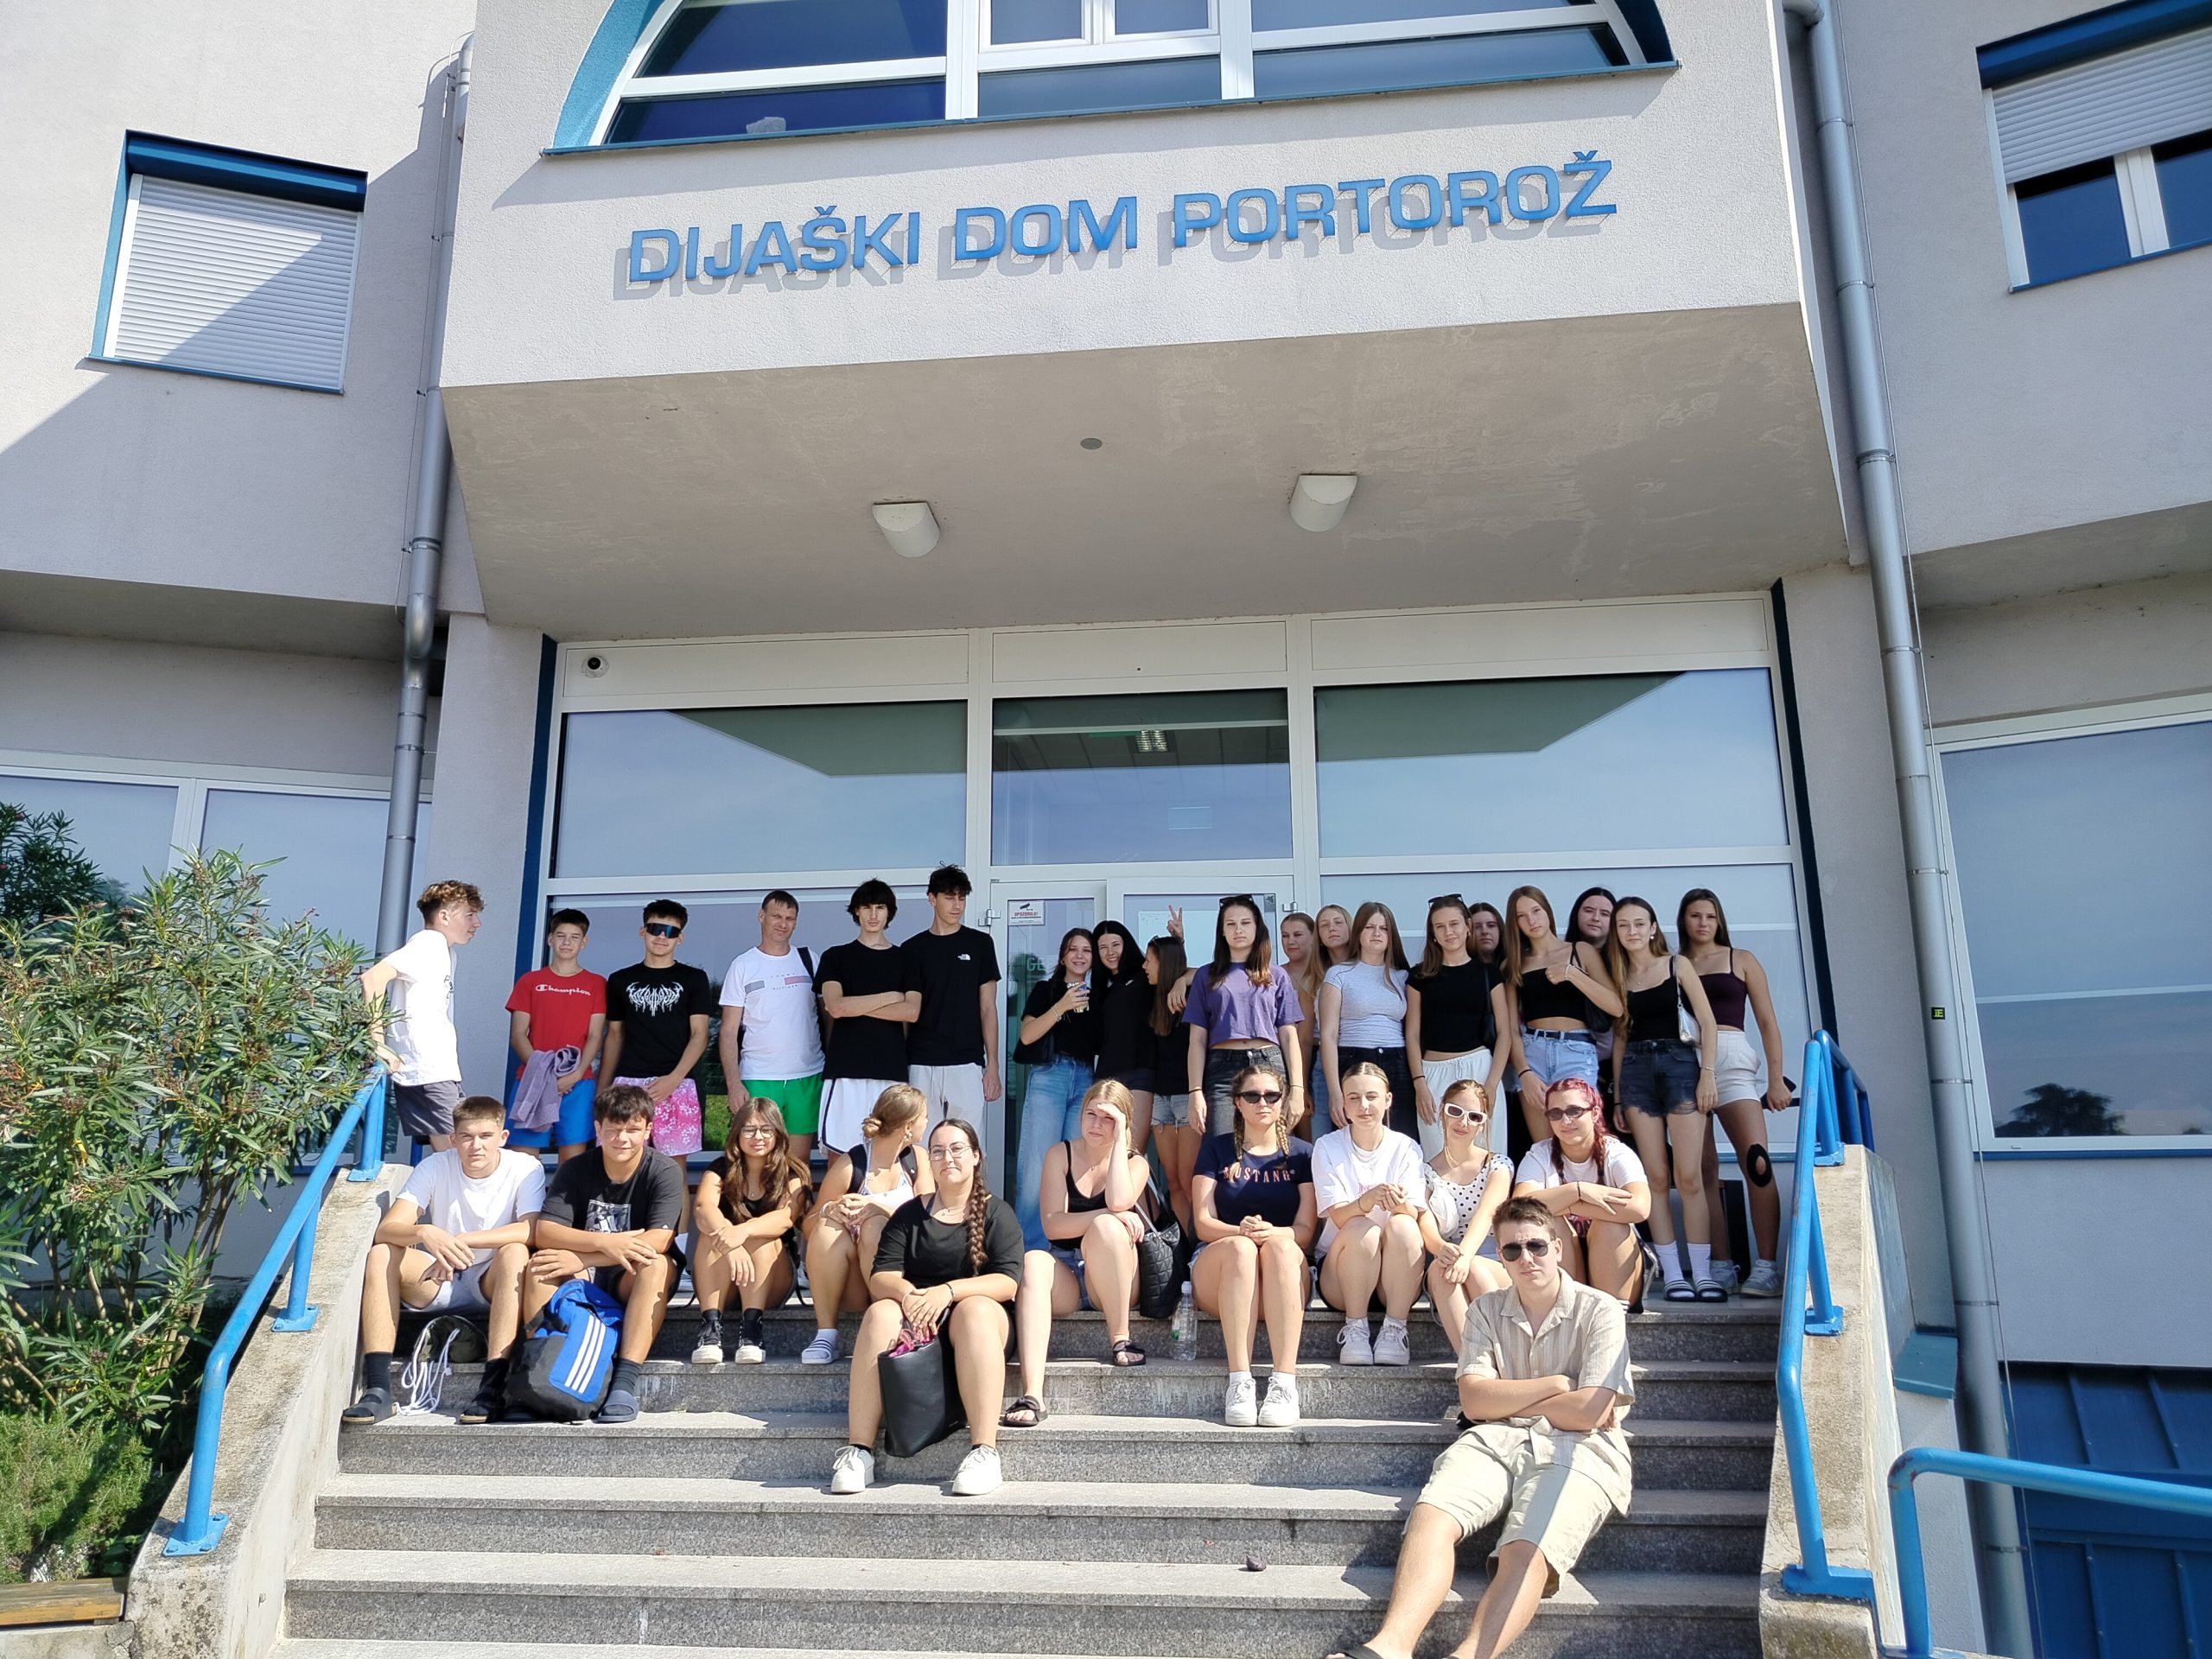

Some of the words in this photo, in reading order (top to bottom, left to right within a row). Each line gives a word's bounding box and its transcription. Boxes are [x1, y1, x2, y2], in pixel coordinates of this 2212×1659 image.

[629, 205, 920, 283] DIJAŠKI
[955, 196, 1137, 260] DOM
[1173, 149, 1617, 248] PORTOROŽ
[536, 984, 591, 995] Champion
